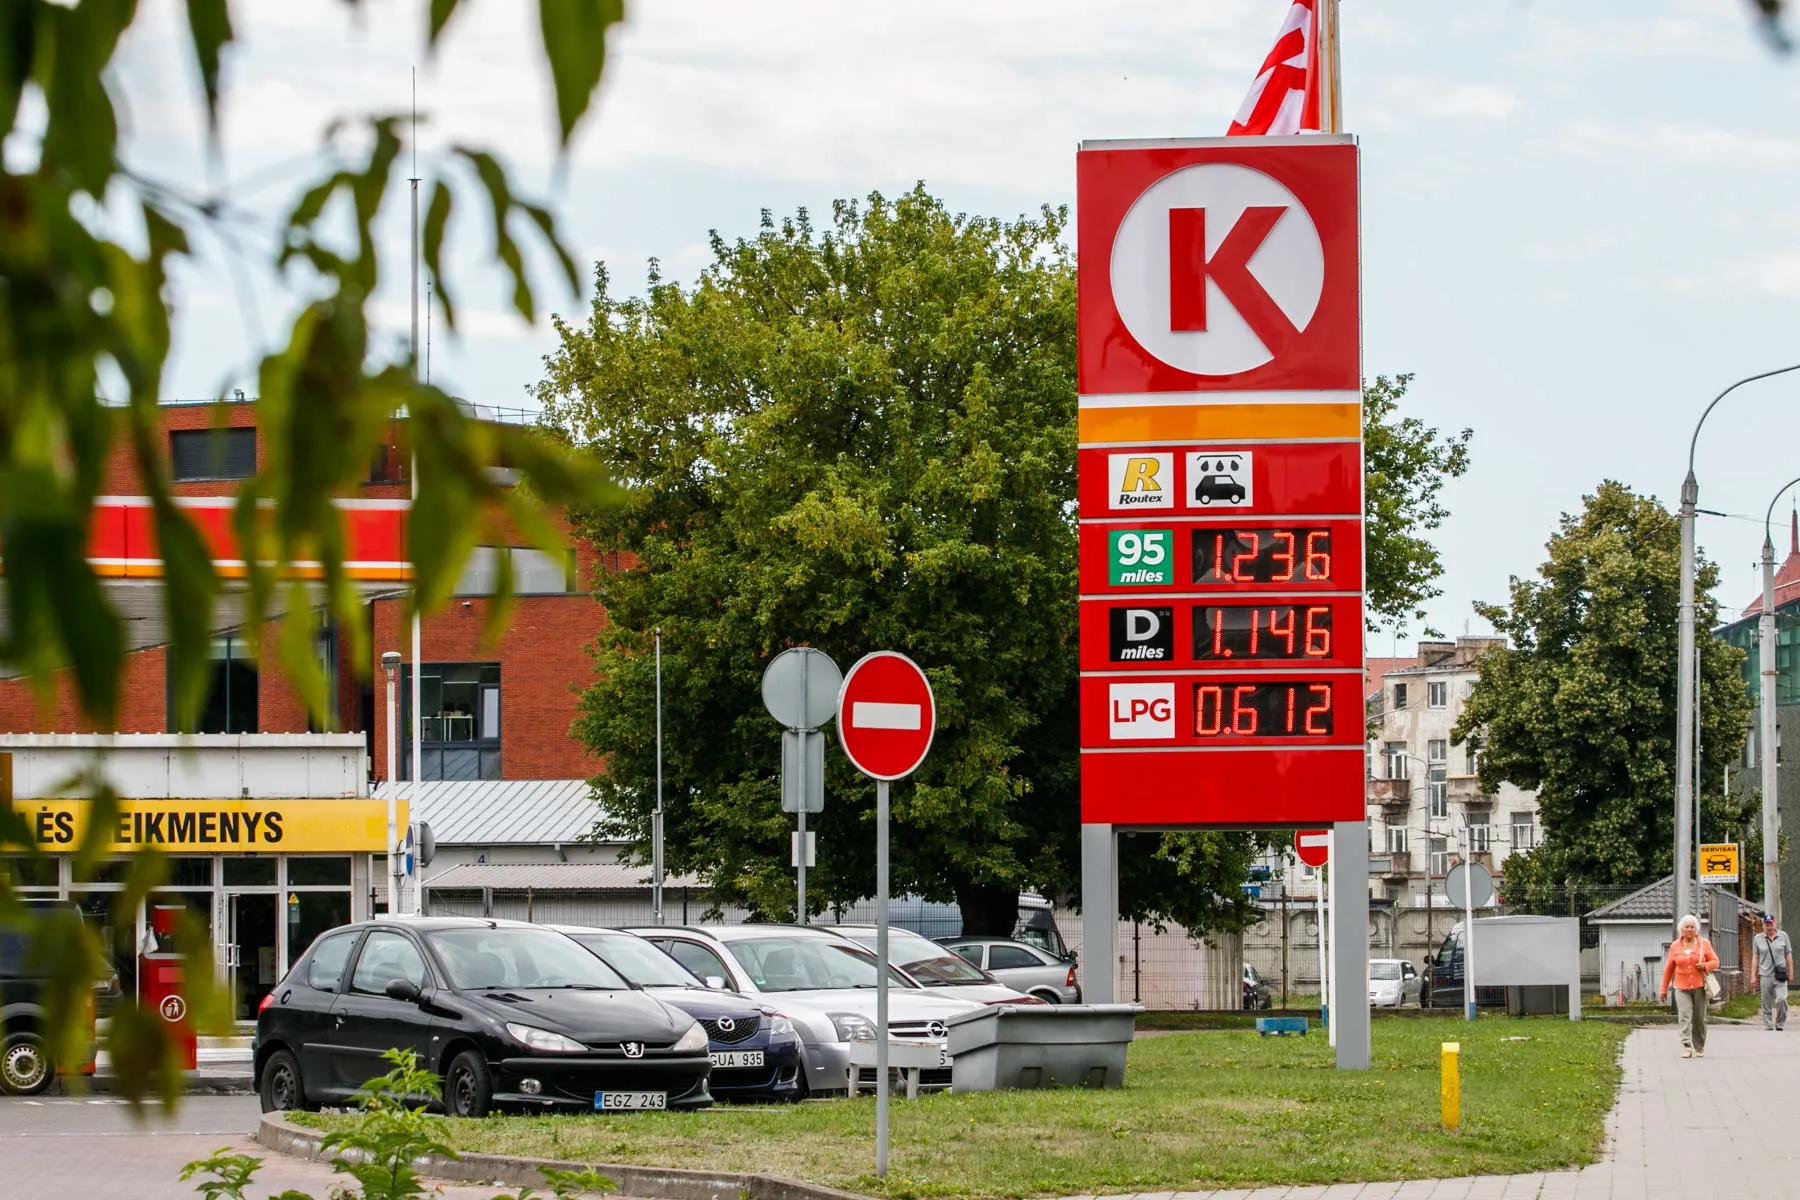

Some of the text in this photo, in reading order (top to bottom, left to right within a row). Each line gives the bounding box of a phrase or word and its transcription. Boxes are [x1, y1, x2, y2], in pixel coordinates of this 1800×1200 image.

[1168, 205, 1303, 359] K
[1122, 457, 1162, 492] R
[1119, 494, 1163, 504] Routex
[1117, 531, 1330, 581] 95 1.236
[1120, 569, 1164, 583] miles
[1126, 607, 1330, 656] D 1.146
[1120, 645, 1165, 659] miles
[1113, 685, 1331, 735] LPG 0.612
[112, 812, 283, 843] EIKMENYS
[710, 1054, 762, 1066] GUA 935
[604, 1094, 664, 1107] EGZ 243
